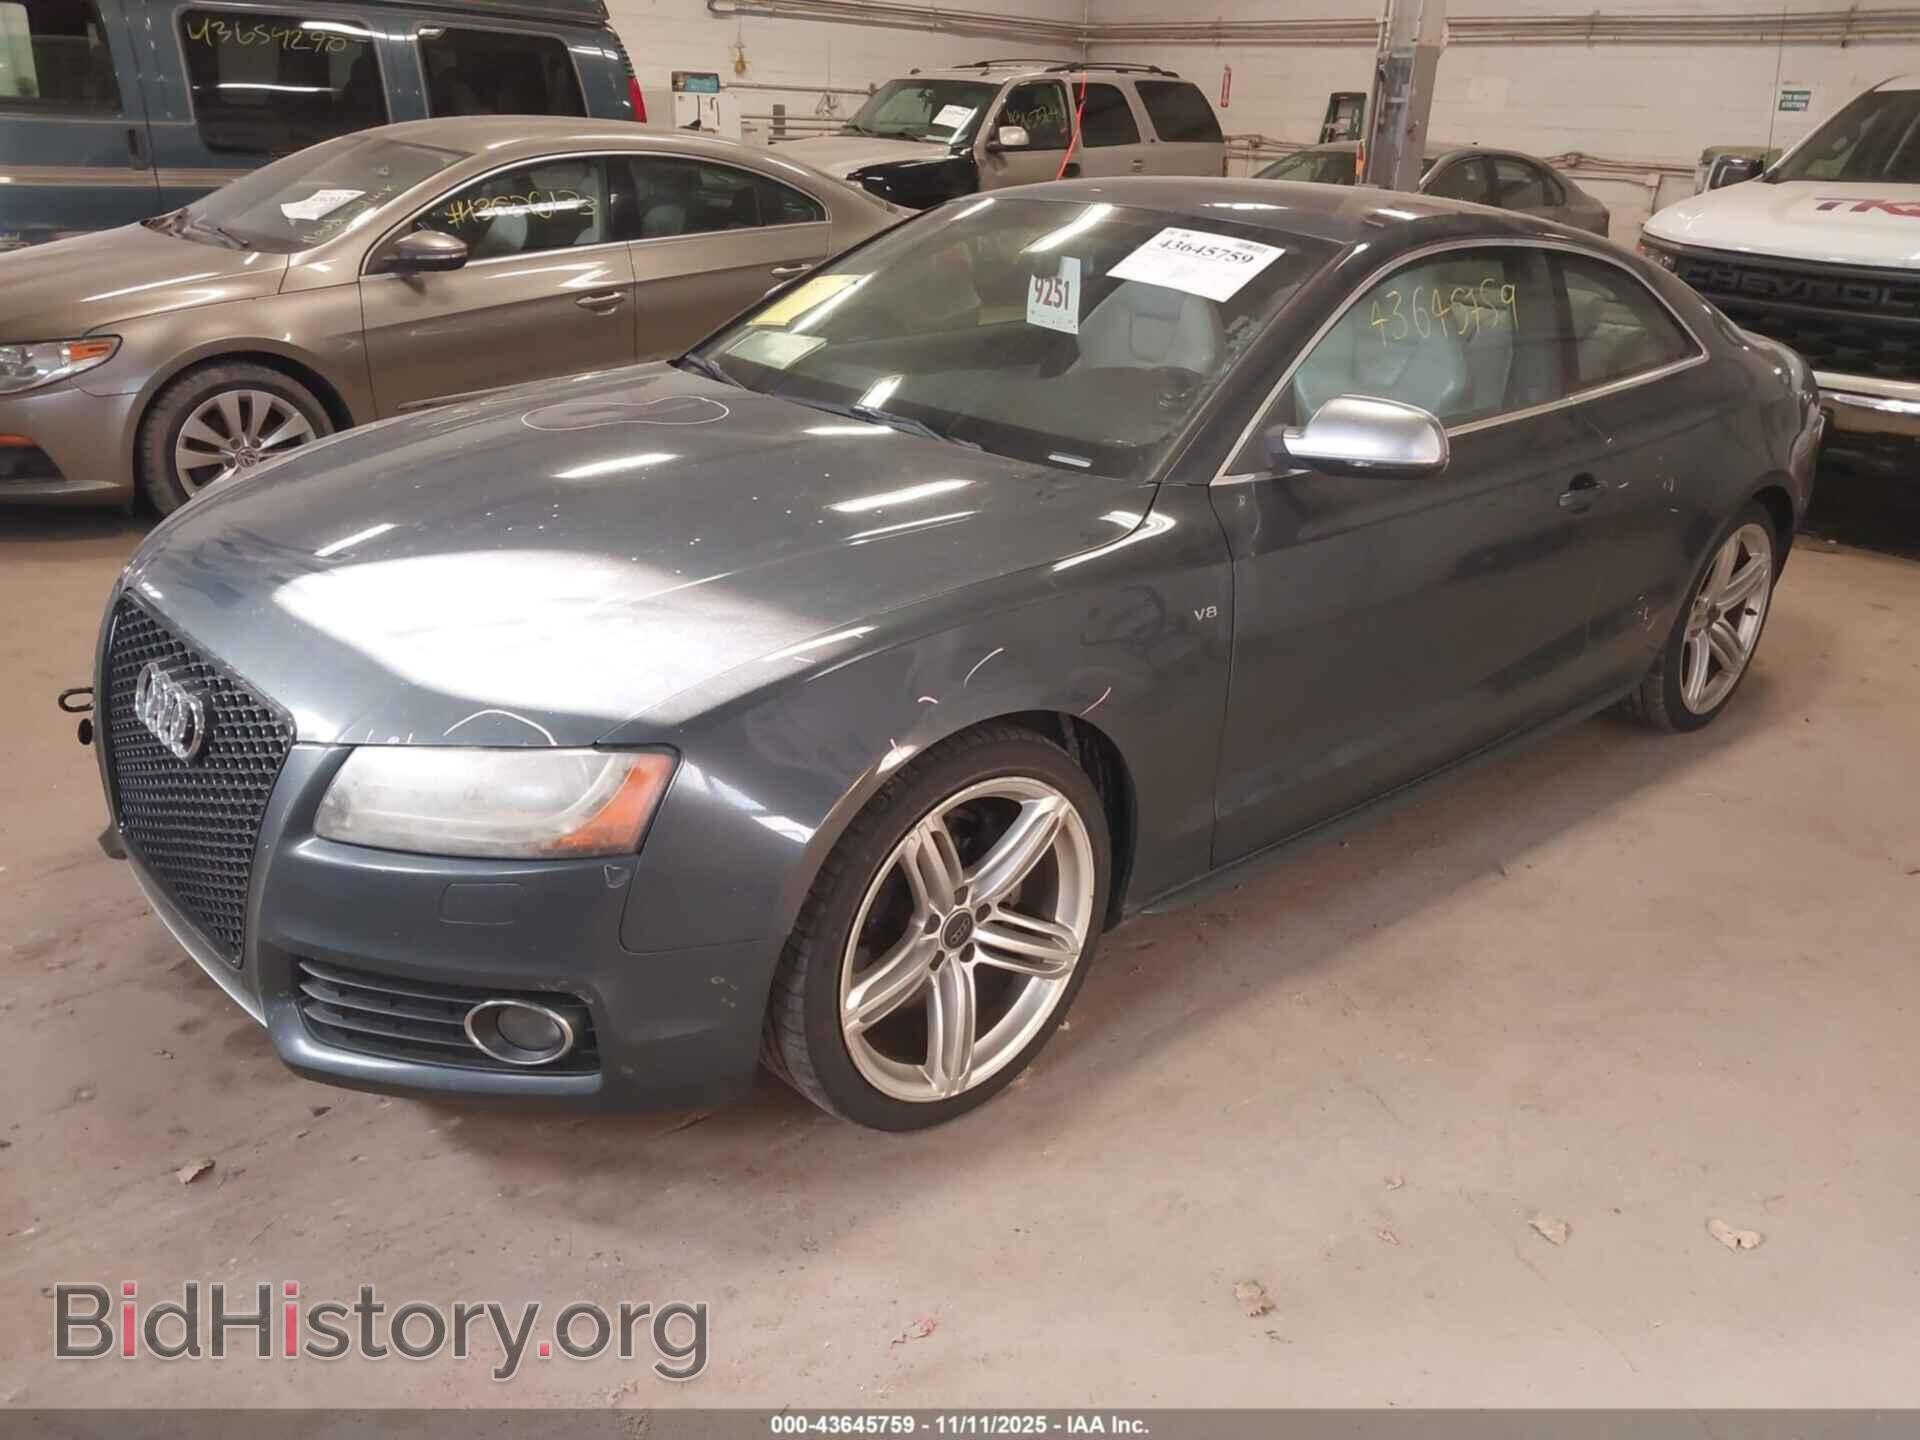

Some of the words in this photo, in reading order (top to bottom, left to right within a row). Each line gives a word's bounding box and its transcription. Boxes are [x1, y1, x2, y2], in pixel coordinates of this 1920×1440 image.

[186, 18, 347, 52] 43654290
[1159, 238, 1255, 265] 43645759
[1034, 276, 1071, 311] 9251
[1369, 278, 1519, 348] 43645759
[1193, 605, 1217, 621] V8
